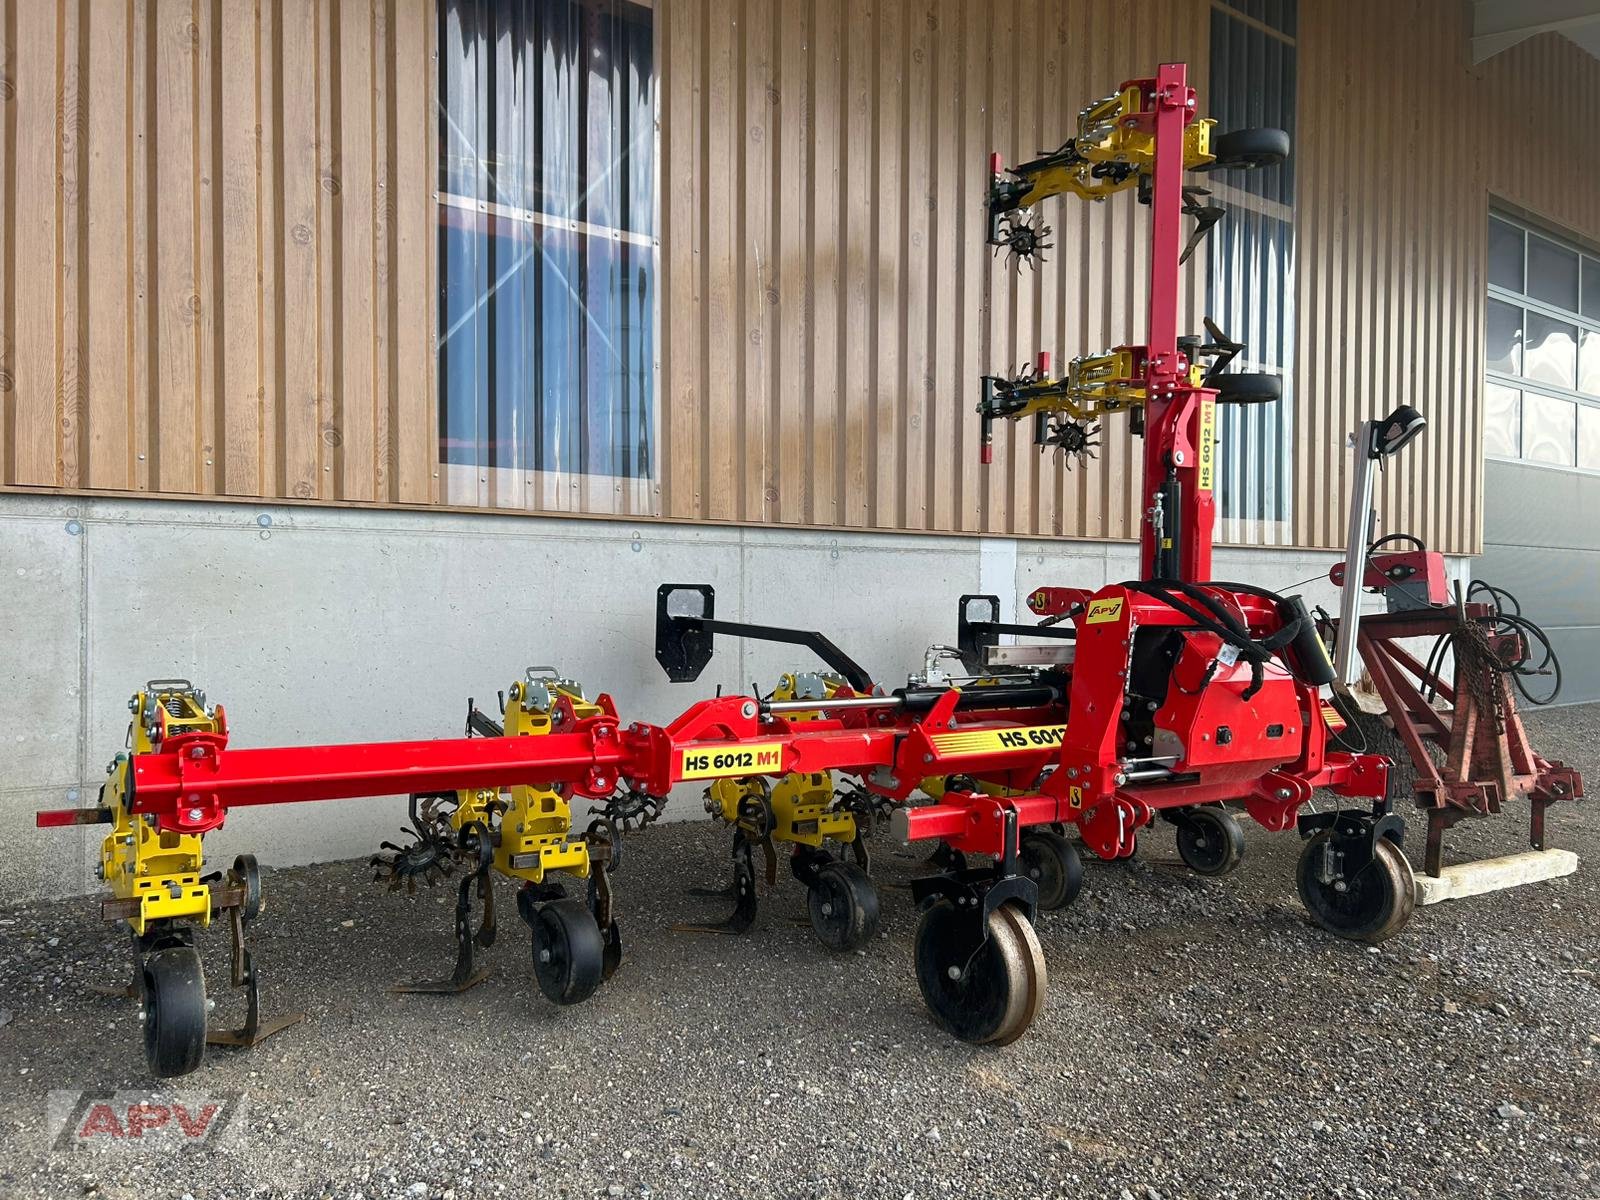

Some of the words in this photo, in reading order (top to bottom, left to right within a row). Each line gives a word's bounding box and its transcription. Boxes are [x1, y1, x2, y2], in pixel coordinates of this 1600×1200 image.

[1204, 404, 1212, 424] M1
[1203, 428, 1211, 463] 6012
[1202, 467, 1210, 487] HS
[997, 731, 1028, 747] HS
[686, 756, 709, 771] HS
[713, 753, 753, 769] 6012
[757, 751, 779, 766] M1
